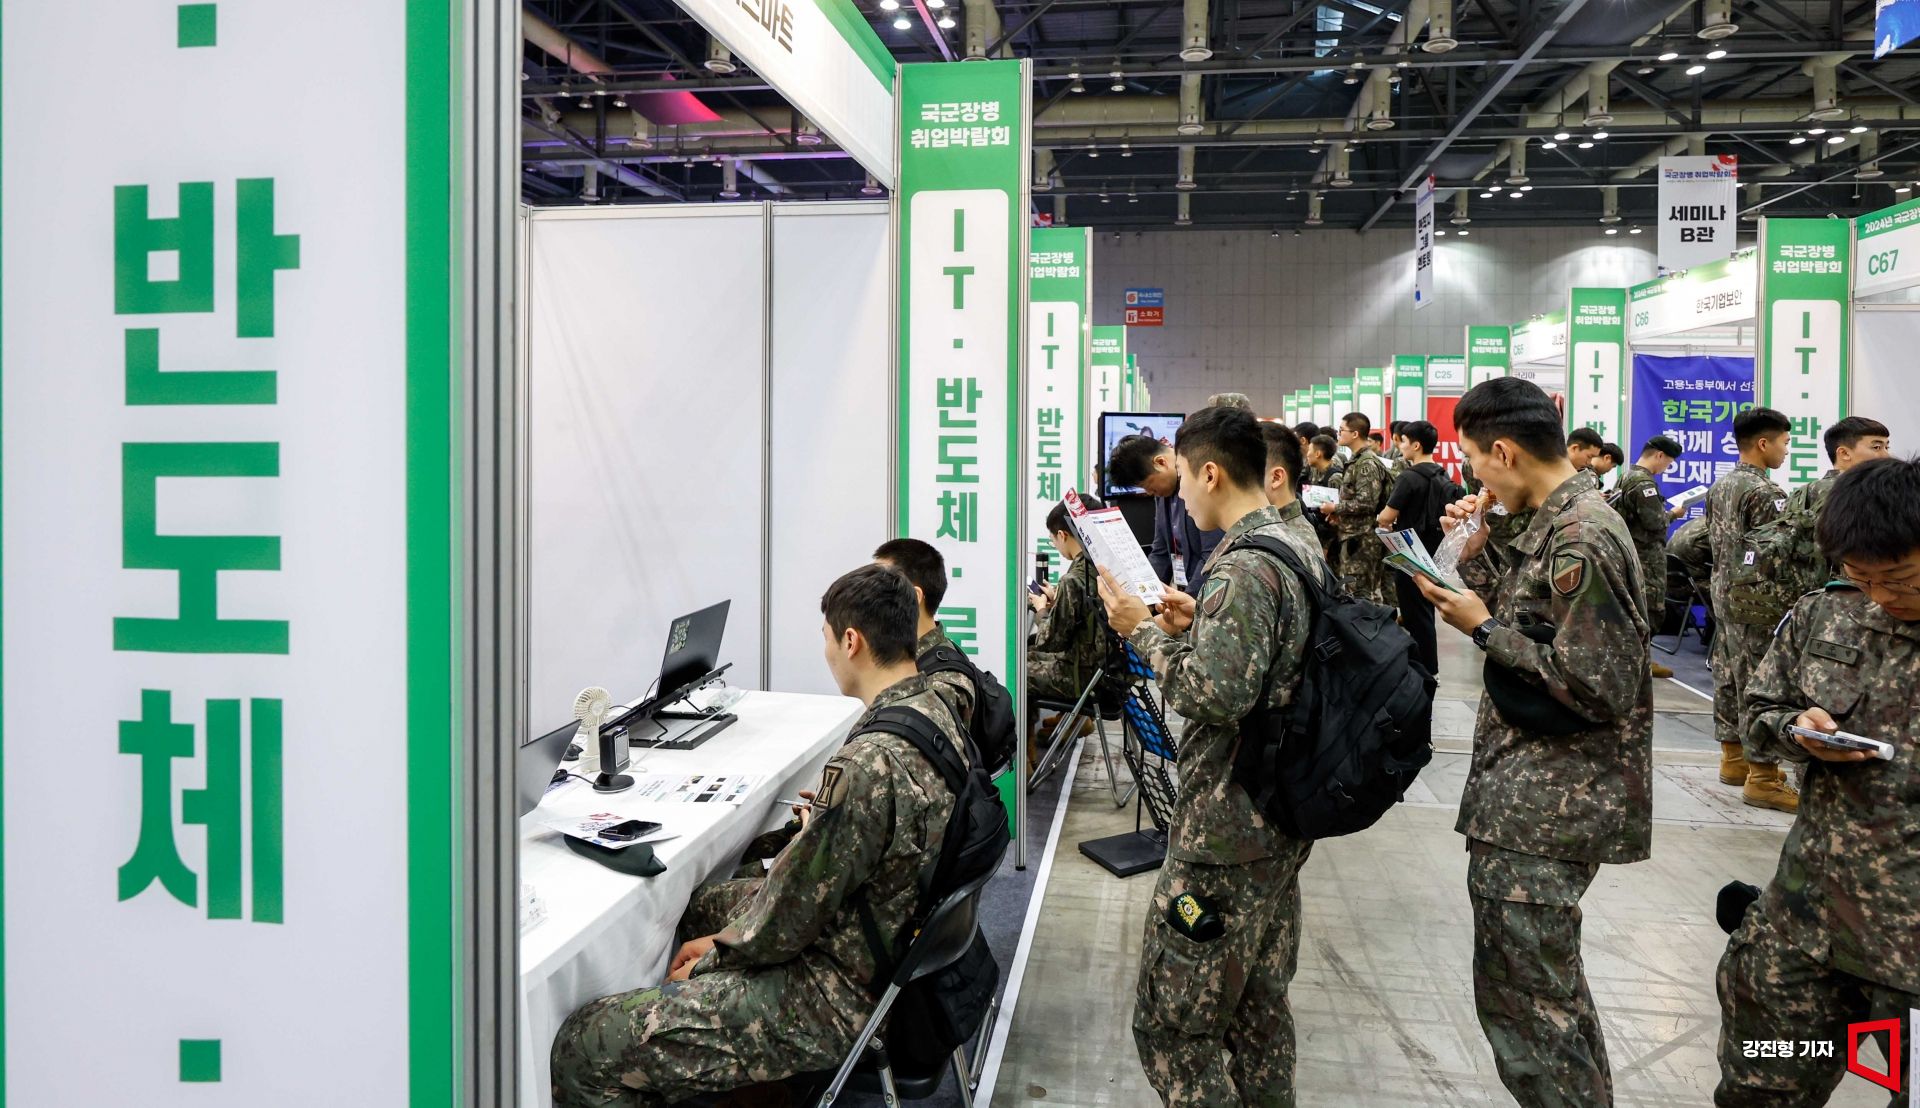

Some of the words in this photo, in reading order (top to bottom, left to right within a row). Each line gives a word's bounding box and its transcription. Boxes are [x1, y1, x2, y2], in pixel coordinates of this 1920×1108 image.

[921, 101, 1000, 123] 국군장병
[911, 126, 1010, 148] 취업박람회
[1669, 205, 1726, 221] 세미나
[1865, 215, 1893, 234] 2024년
[1894, 206, 1920, 224] 국군장
[1680, 226, 1715, 242] B관
[1030, 252, 1074, 264] 국군장병
[1780, 244, 1835, 259] 국군장병
[1773, 260, 1842, 274] 취업박람회
[1868, 249, 1899, 276] C67
[1030, 266, 1080, 278] 업박람회
[1696, 289, 1743, 314] 한국기업보안
[1579, 305, 1616, 315] 국군장병
[1635, 311, 1649, 327] C66
[1434, 370, 1453, 379] C25
[1663, 379, 1737, 391] 고용노동부에서
[936, 377, 983, 543] 반도체
[1036, 408, 1064, 501] 반도체
[114, 177, 300, 924] 반도체
